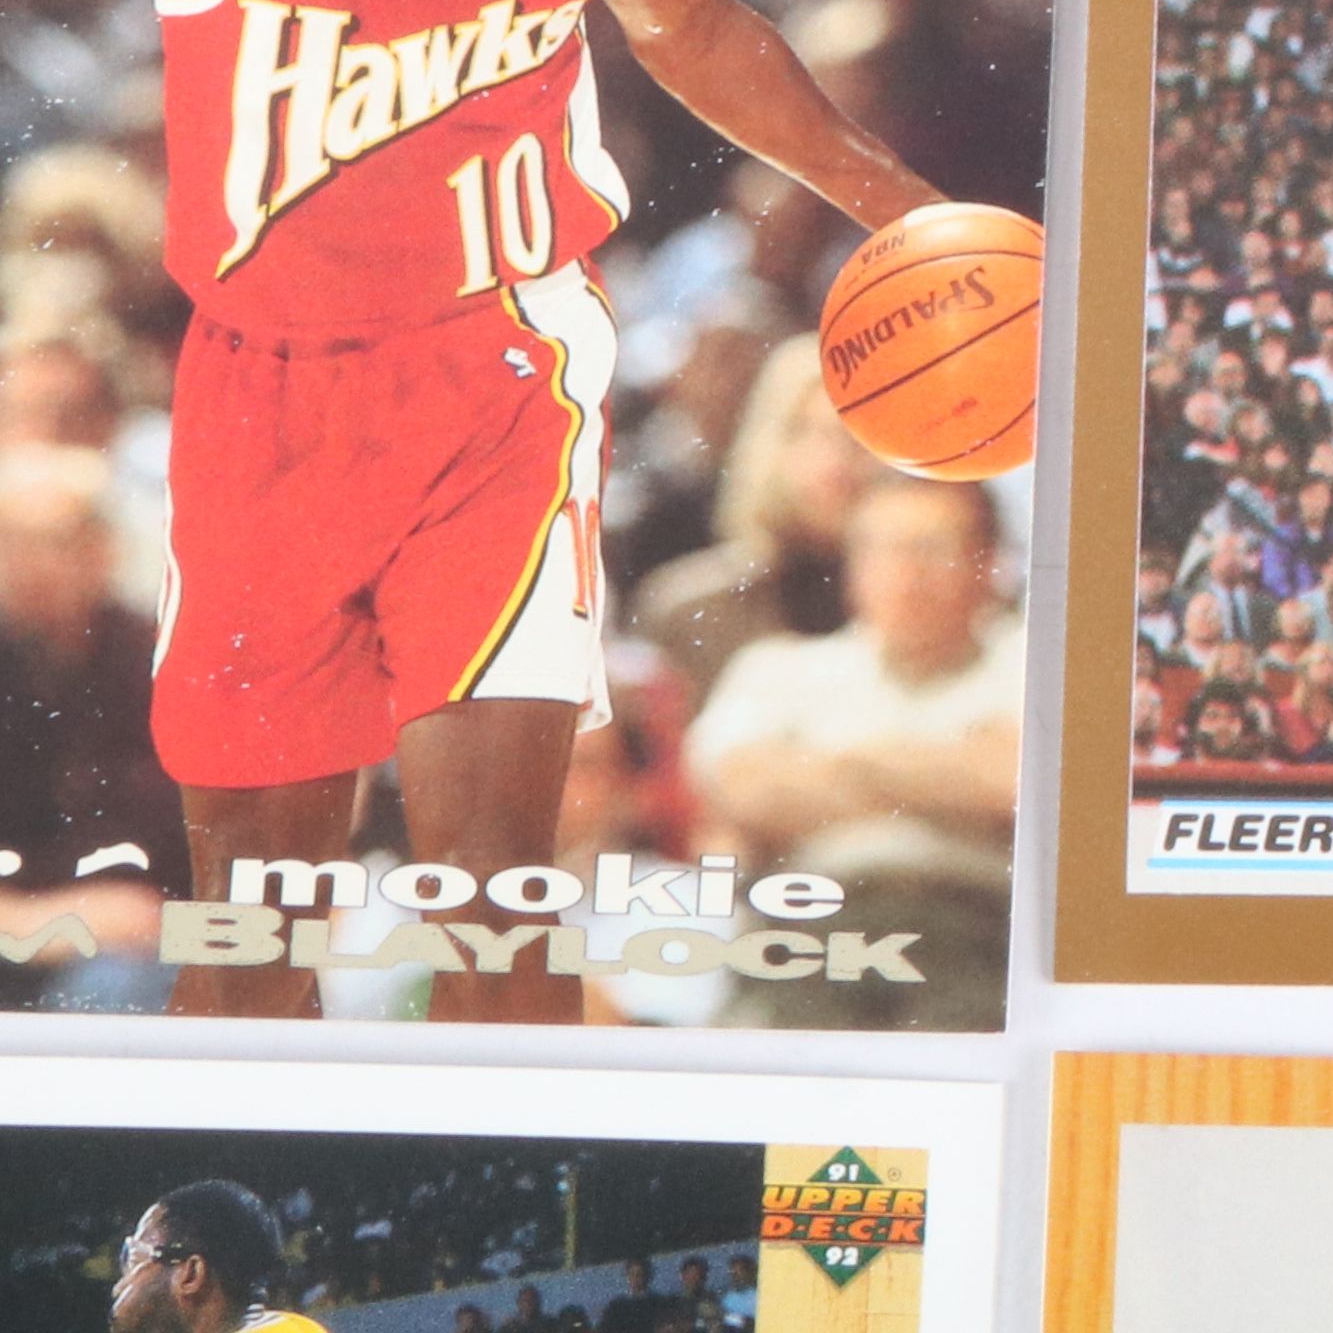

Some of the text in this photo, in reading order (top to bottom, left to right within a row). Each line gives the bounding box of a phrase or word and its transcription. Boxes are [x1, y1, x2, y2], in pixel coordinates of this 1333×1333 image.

[446, 132, 555, 299] 10
[860, 232, 907, 266] NBA
[826, 264, 996, 391] SPALDING
[228, 852, 845, 921] mookie
[158, 900, 927, 983] BLAYLOCK
[827, 1162, 860, 1182] 91
[762, 1185, 926, 1215] UPPER
[825, 1246, 859, 1266] 92
